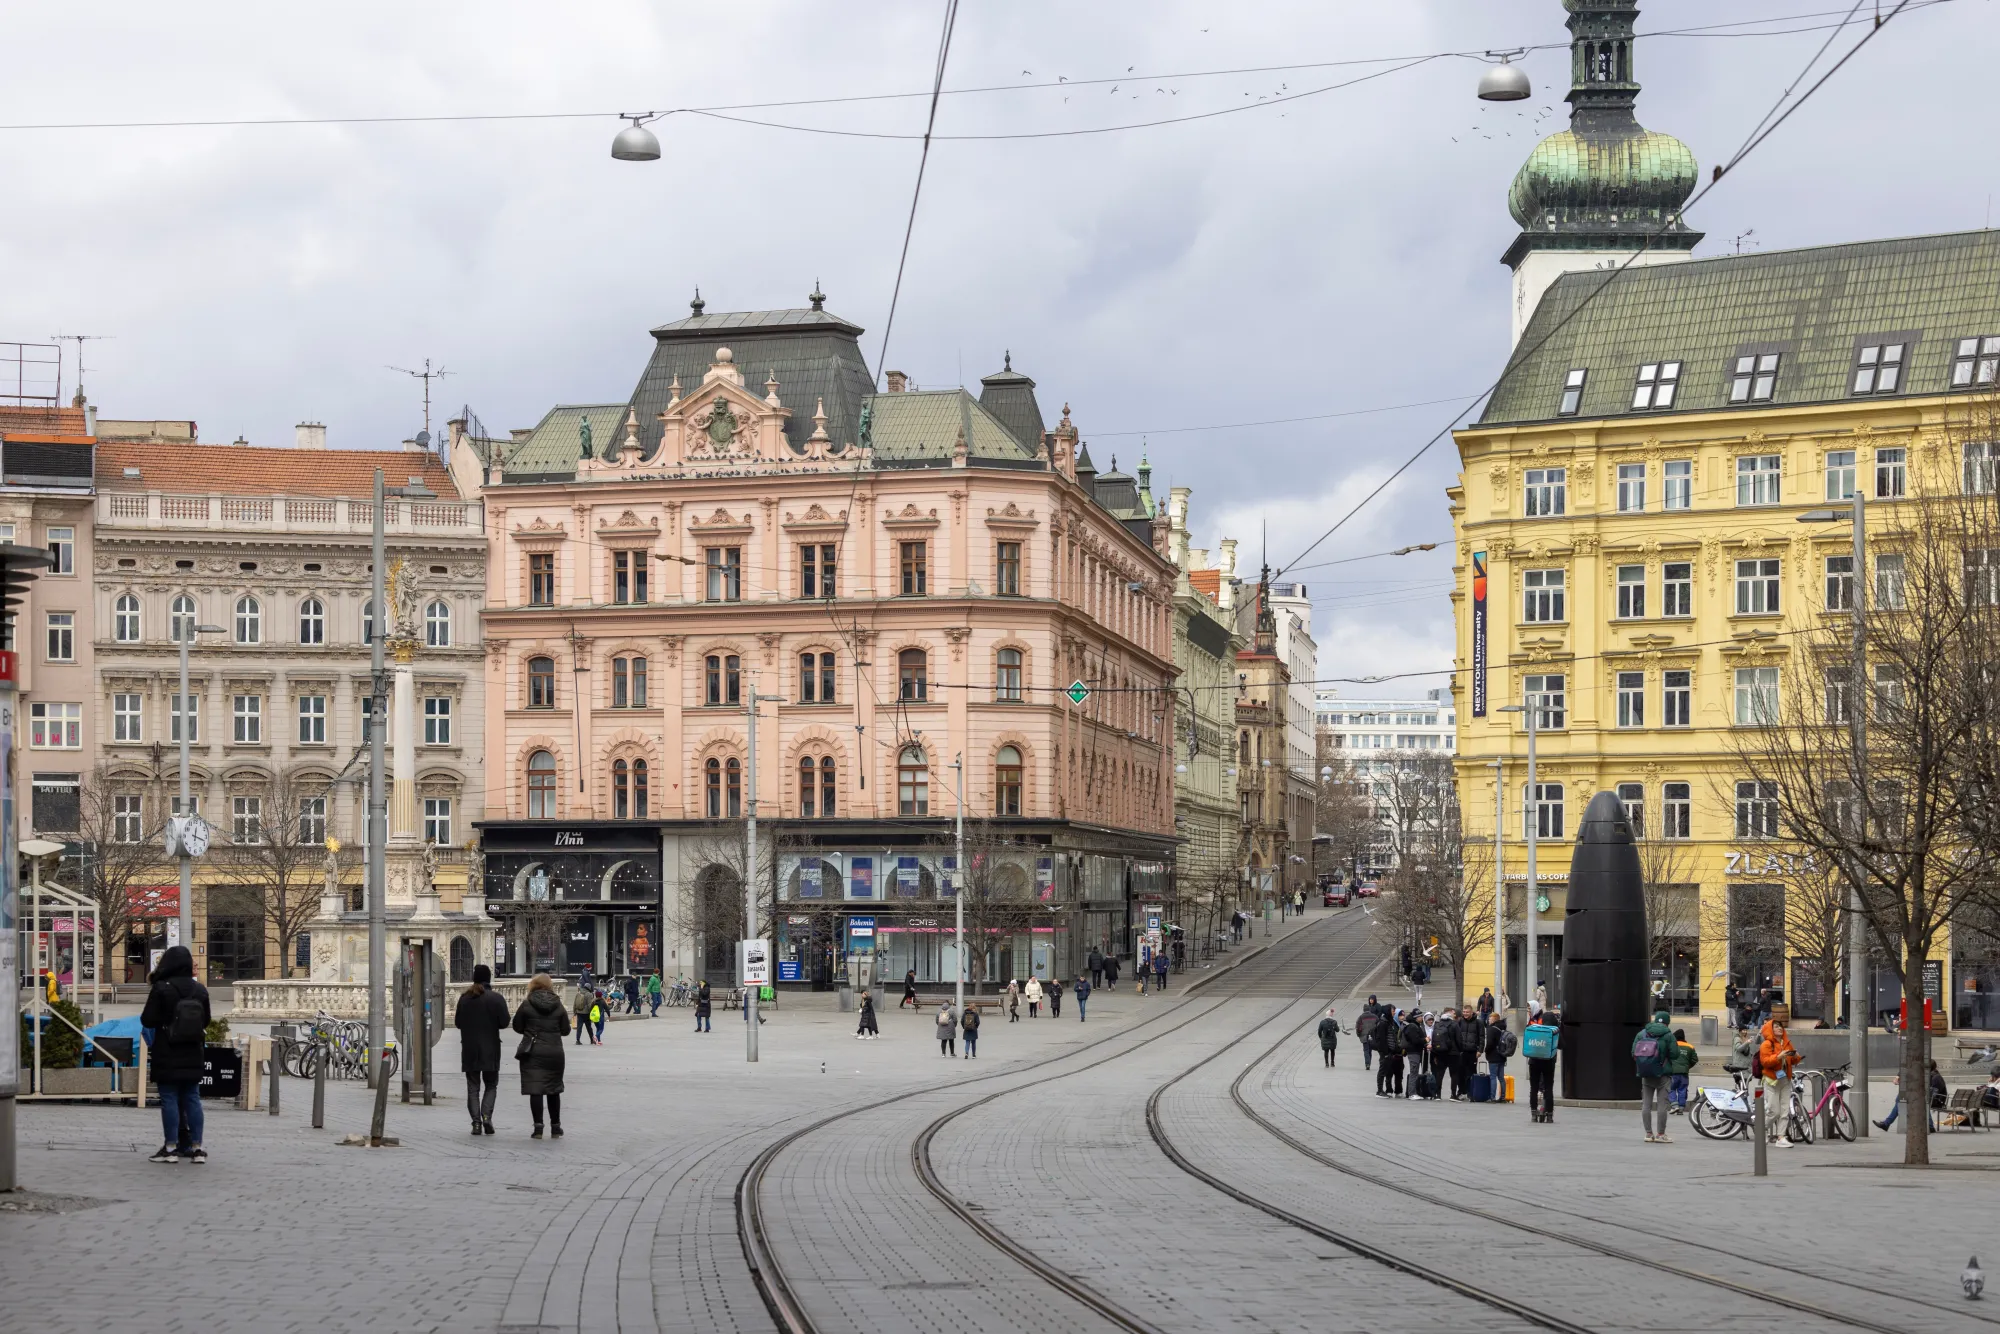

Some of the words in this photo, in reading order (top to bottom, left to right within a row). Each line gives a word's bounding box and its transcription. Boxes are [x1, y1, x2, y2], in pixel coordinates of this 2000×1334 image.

[849, 918, 874, 926] Bohemia
[908, 918, 938, 926] CENTEX
[1528, 1038, 1547, 1047] Wolt
